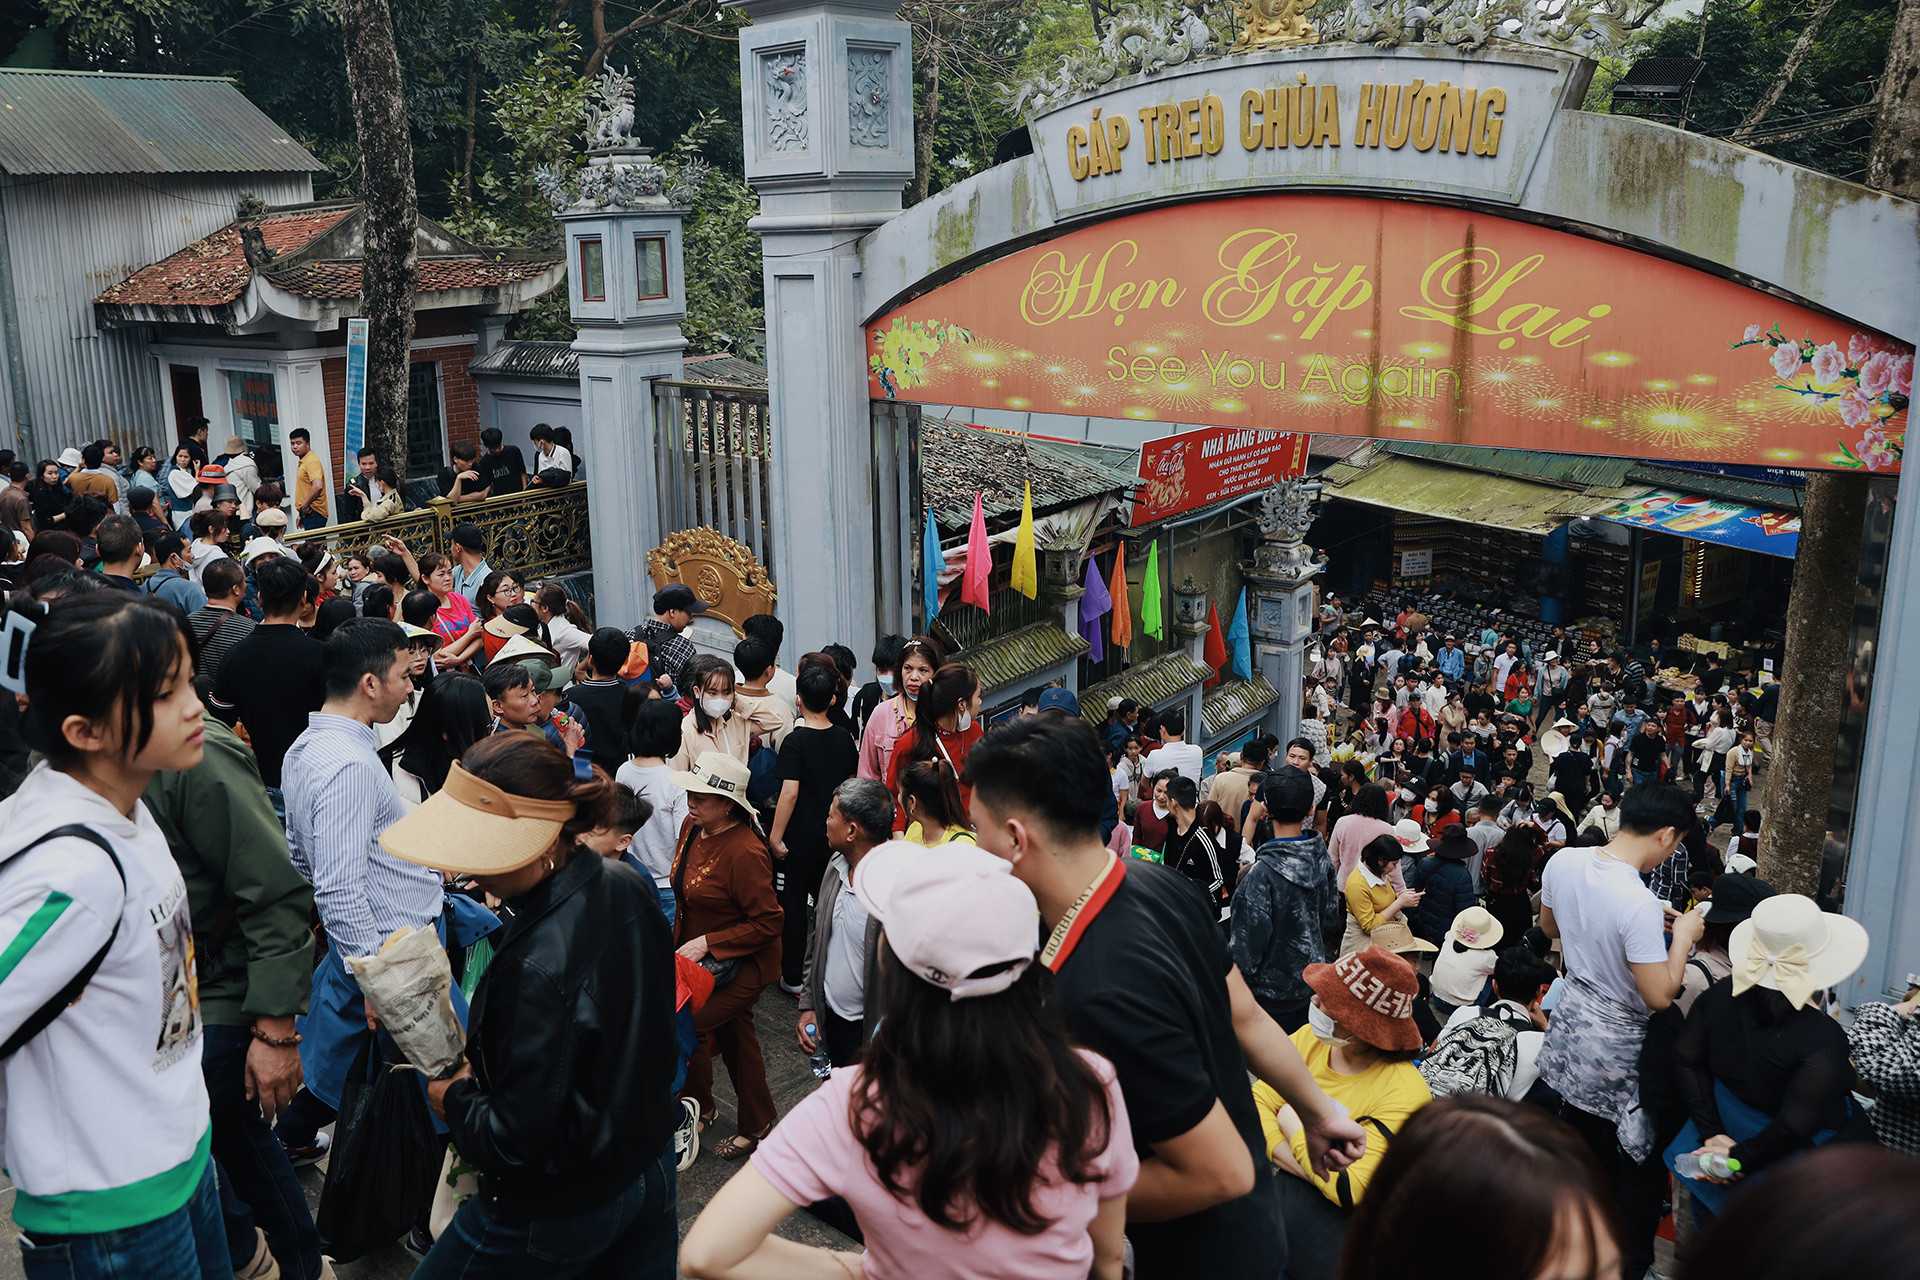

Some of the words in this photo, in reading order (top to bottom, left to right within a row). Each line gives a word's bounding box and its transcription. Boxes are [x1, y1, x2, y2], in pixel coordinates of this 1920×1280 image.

[1067, 108, 1131, 181] CÁP
[1138, 94, 1224, 165] TREO
[1239, 72, 1341, 152] CHÙA
[1353, 78, 1507, 157] HƯƠNG
[1020, 240, 1187, 327] Hẹn
[1202, 228, 1375, 341] Gặp
[1399, 246, 1612, 350] Lại
[1106, 346, 1187, 384] See
[1200, 350, 1286, 390] You
[1300, 354, 1463, 405] Again
[1201, 432, 1224, 459] NHÀ
